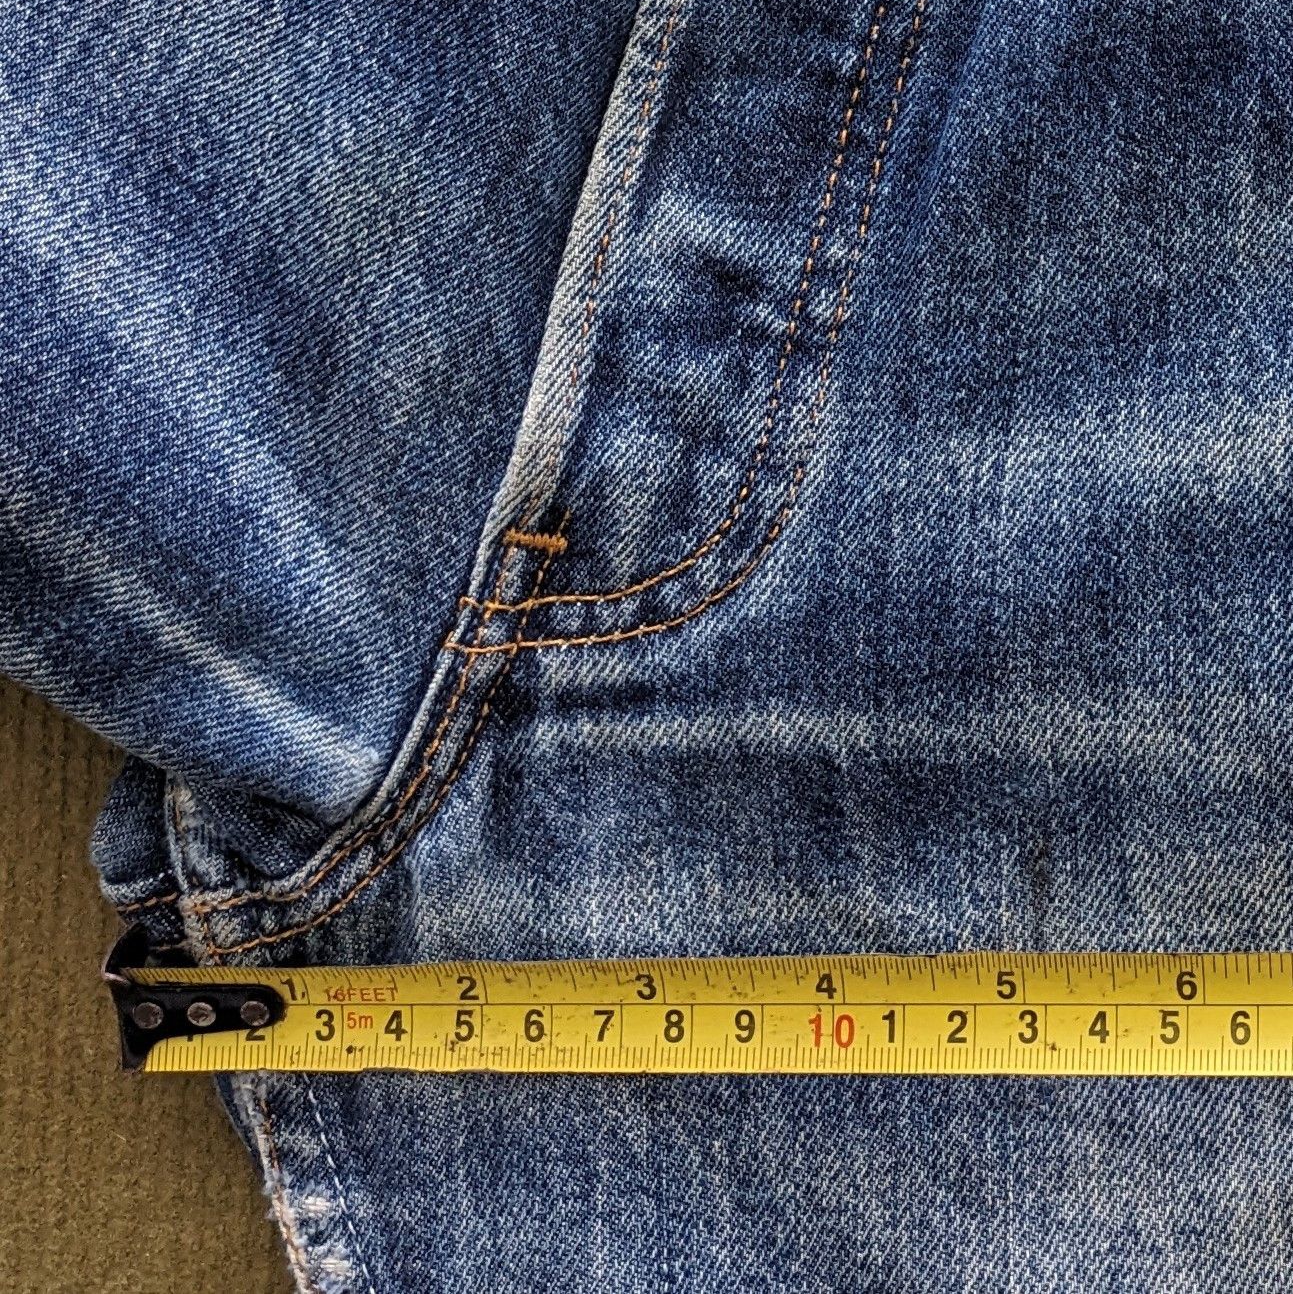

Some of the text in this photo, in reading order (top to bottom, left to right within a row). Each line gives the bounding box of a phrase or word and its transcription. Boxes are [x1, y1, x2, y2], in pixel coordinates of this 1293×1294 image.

[280, 978, 298, 1001] 1
[456, 975, 480, 1001] 2
[636, 973, 657, 1000] 3
[815, 972, 838, 1000] 4
[996, 971, 1017, 999] 5
[1176, 971, 1198, 1000] 6
[315, 1009, 336, 1041] 3
[347, 1011, 374, 1029] 5m
[384, 1009, 407, 1041] 4
[455, 1009, 475, 1042] 5
[524, 1009, 545, 1042] 6
[593, 1010, 615, 1041] 7
[664, 1010, 686, 1043] 8
[734, 1010, 756, 1043] 9
[808, 1013, 855, 1048] 10
[881, 1010, 897, 1043] 1
[946, 1010, 969, 1043] 2
[1017, 1010, 1039, 1044] 3
[1087, 1010, 1110, 1044] 4
[1159, 1011, 1180, 1044] 5
[1230, 1011, 1251, 1045] 6
